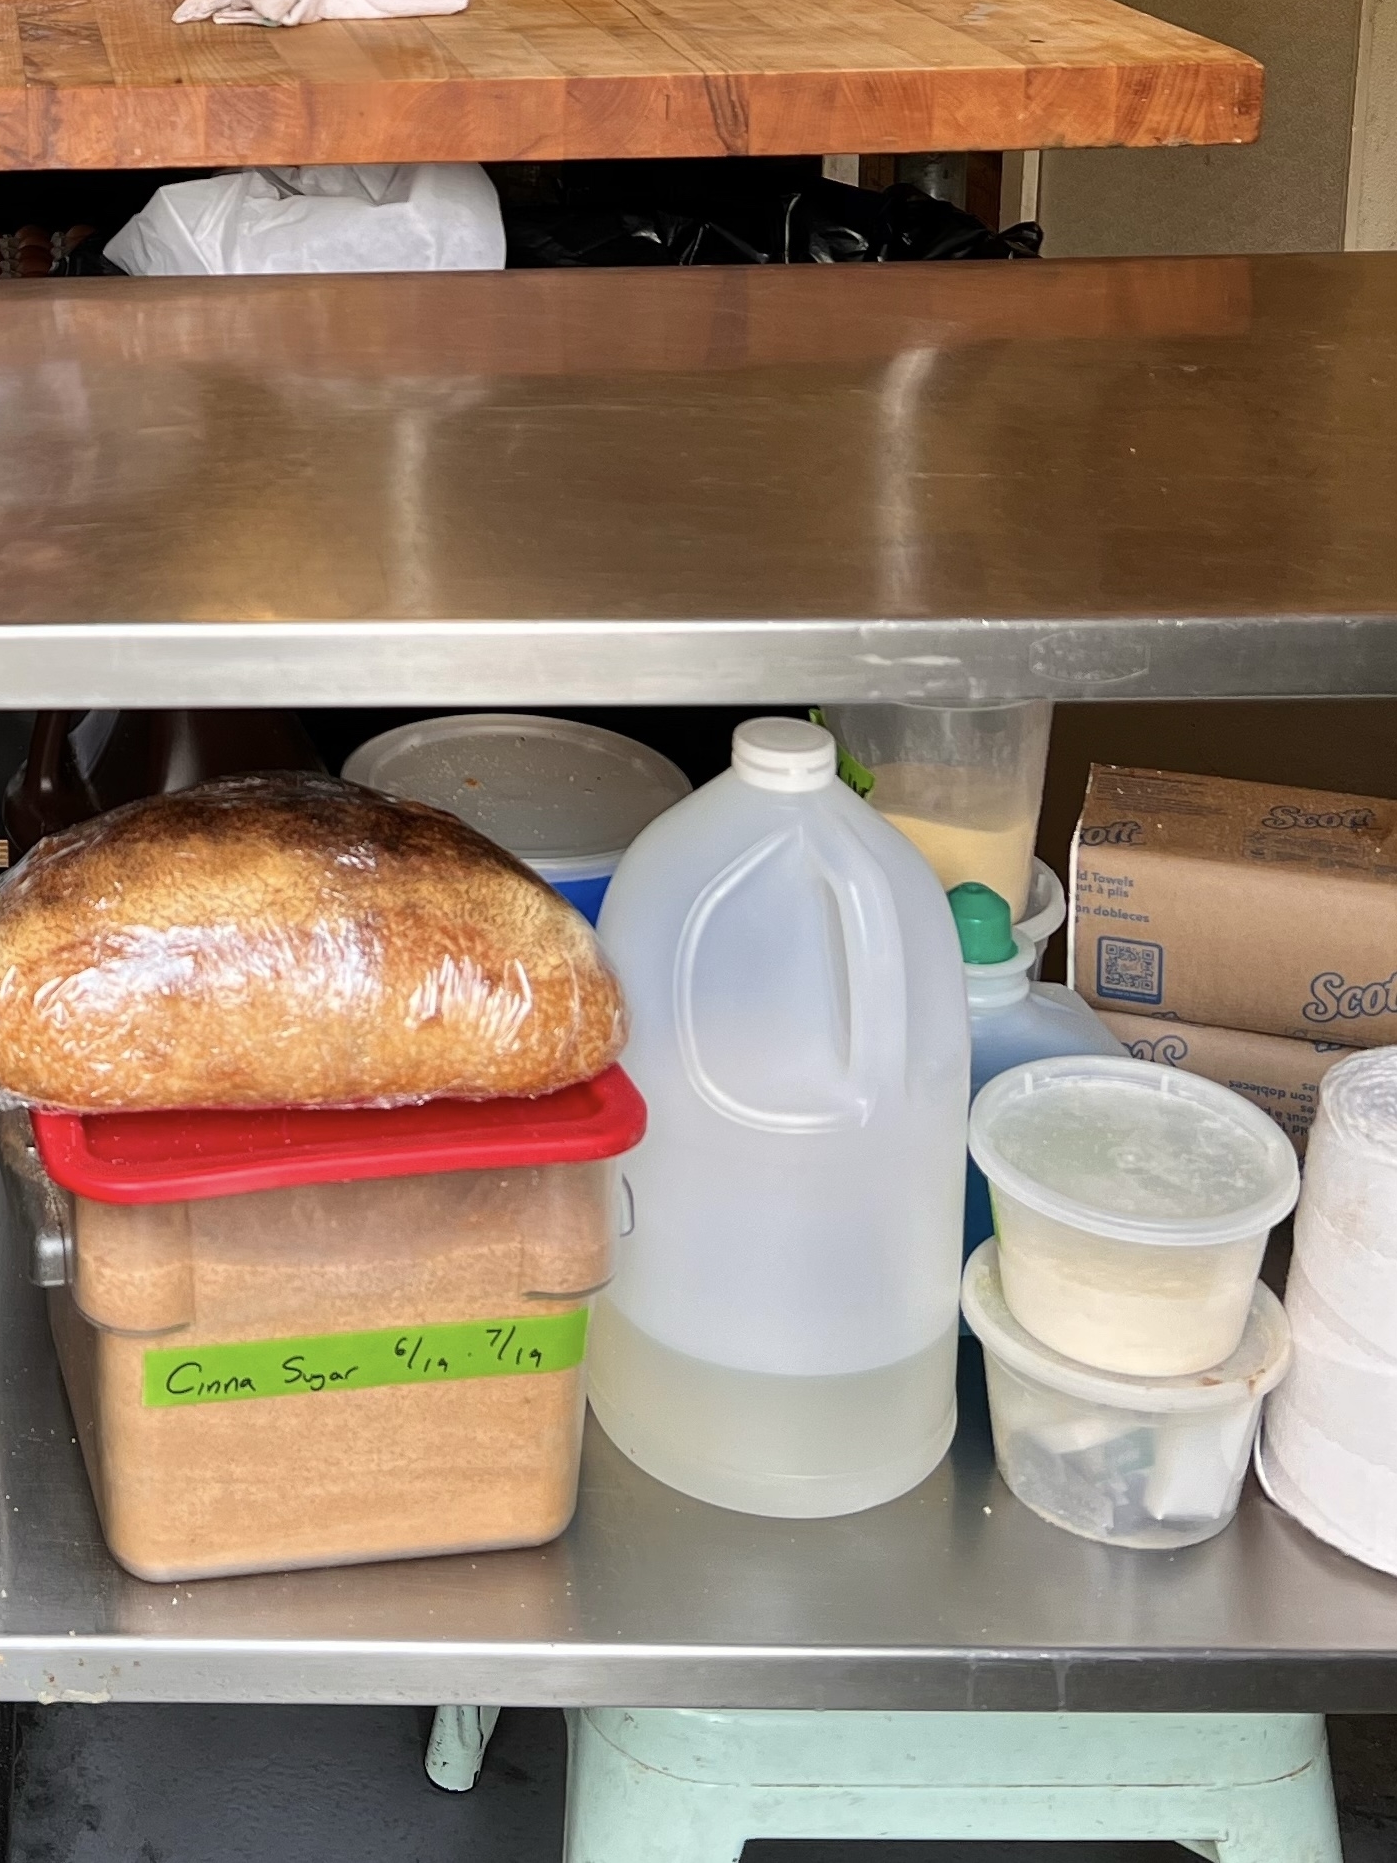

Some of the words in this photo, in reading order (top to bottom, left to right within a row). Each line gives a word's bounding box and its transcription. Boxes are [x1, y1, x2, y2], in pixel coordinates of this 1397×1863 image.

[1261, 805, 1378, 831] Scott
[1079, 820, 1142, 847] ott
[1090, 871, 1135, 888] Towels
[1107, 887, 1130, 899] plis
[1092, 905, 1151, 923] dobleces
[1228, 1079, 1287, 1100] dobleces
[165, 1360, 258, 1397] Cinna
[281, 1354, 360, 1392] Sugar
